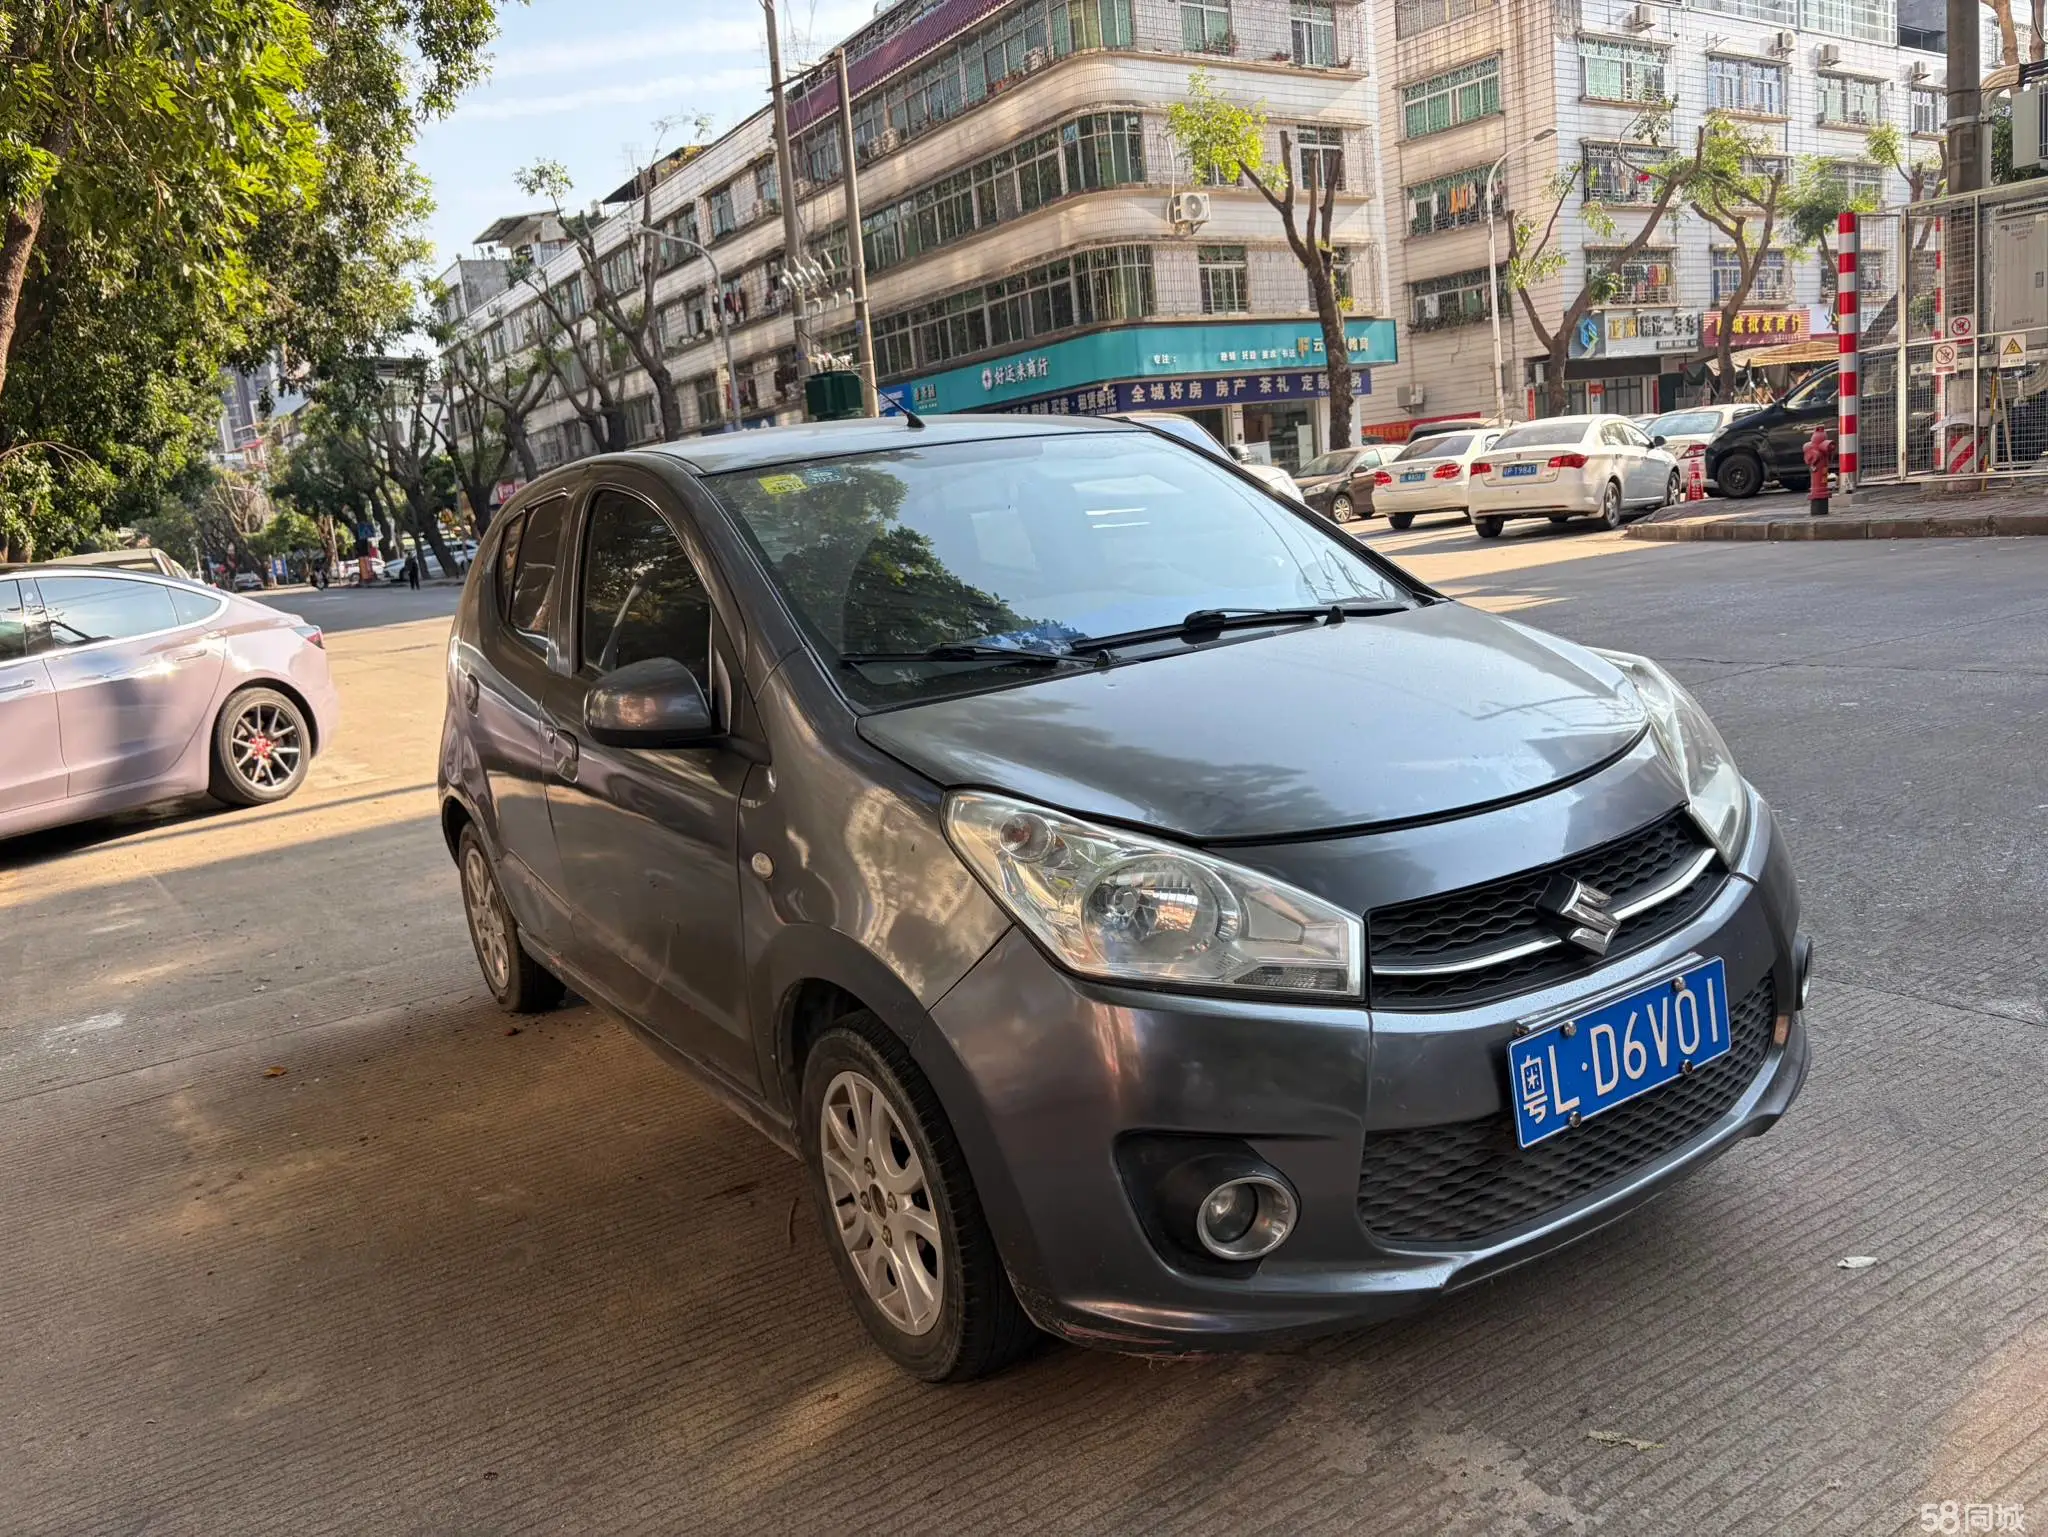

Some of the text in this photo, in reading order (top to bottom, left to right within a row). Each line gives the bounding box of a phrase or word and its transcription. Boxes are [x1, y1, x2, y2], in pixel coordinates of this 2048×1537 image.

[994, 356, 1048, 385] 好运来商行
[1131, 372, 1362, 403] 全城好房 房产 茶礼 定制务
